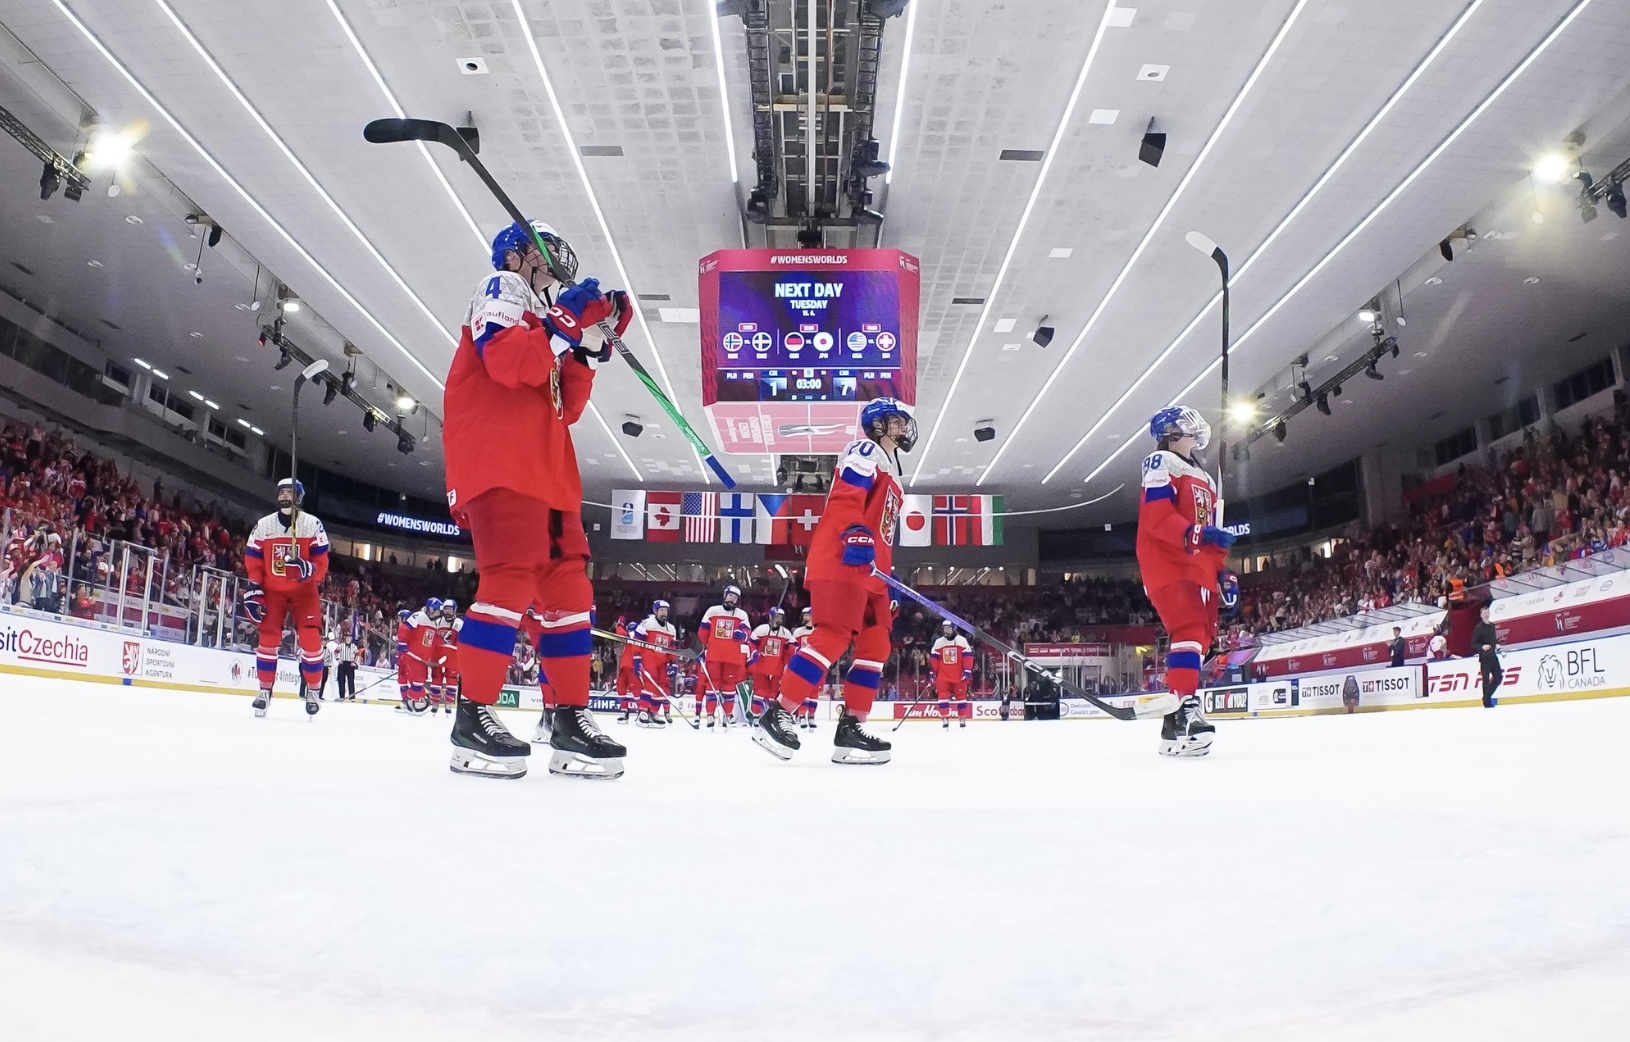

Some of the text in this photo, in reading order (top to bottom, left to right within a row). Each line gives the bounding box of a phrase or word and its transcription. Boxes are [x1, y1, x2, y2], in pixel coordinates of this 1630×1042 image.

[770, 255, 848, 265] #WOMENSWORLDS
[485, 276, 502, 299] 4
[774, 283, 843, 297] NEXT DAY
[790, 300, 828, 309] TUESDAY
[770, 382, 777, 396] 1
[841, 381, 849, 396] 7
[1143, 453, 1163, 477] 98
[377, 512, 460, 536] #WOMENSWORLDS
[1567, 648, 1605, 676] BFL
[1376, 677, 1410, 692] TISSOT
[1427, 672, 1469, 693] TSN
[1568, 676, 1606, 689] CANADA
[1313, 684, 1339, 697] TISSOT
[1205, 691, 1214, 713] G
